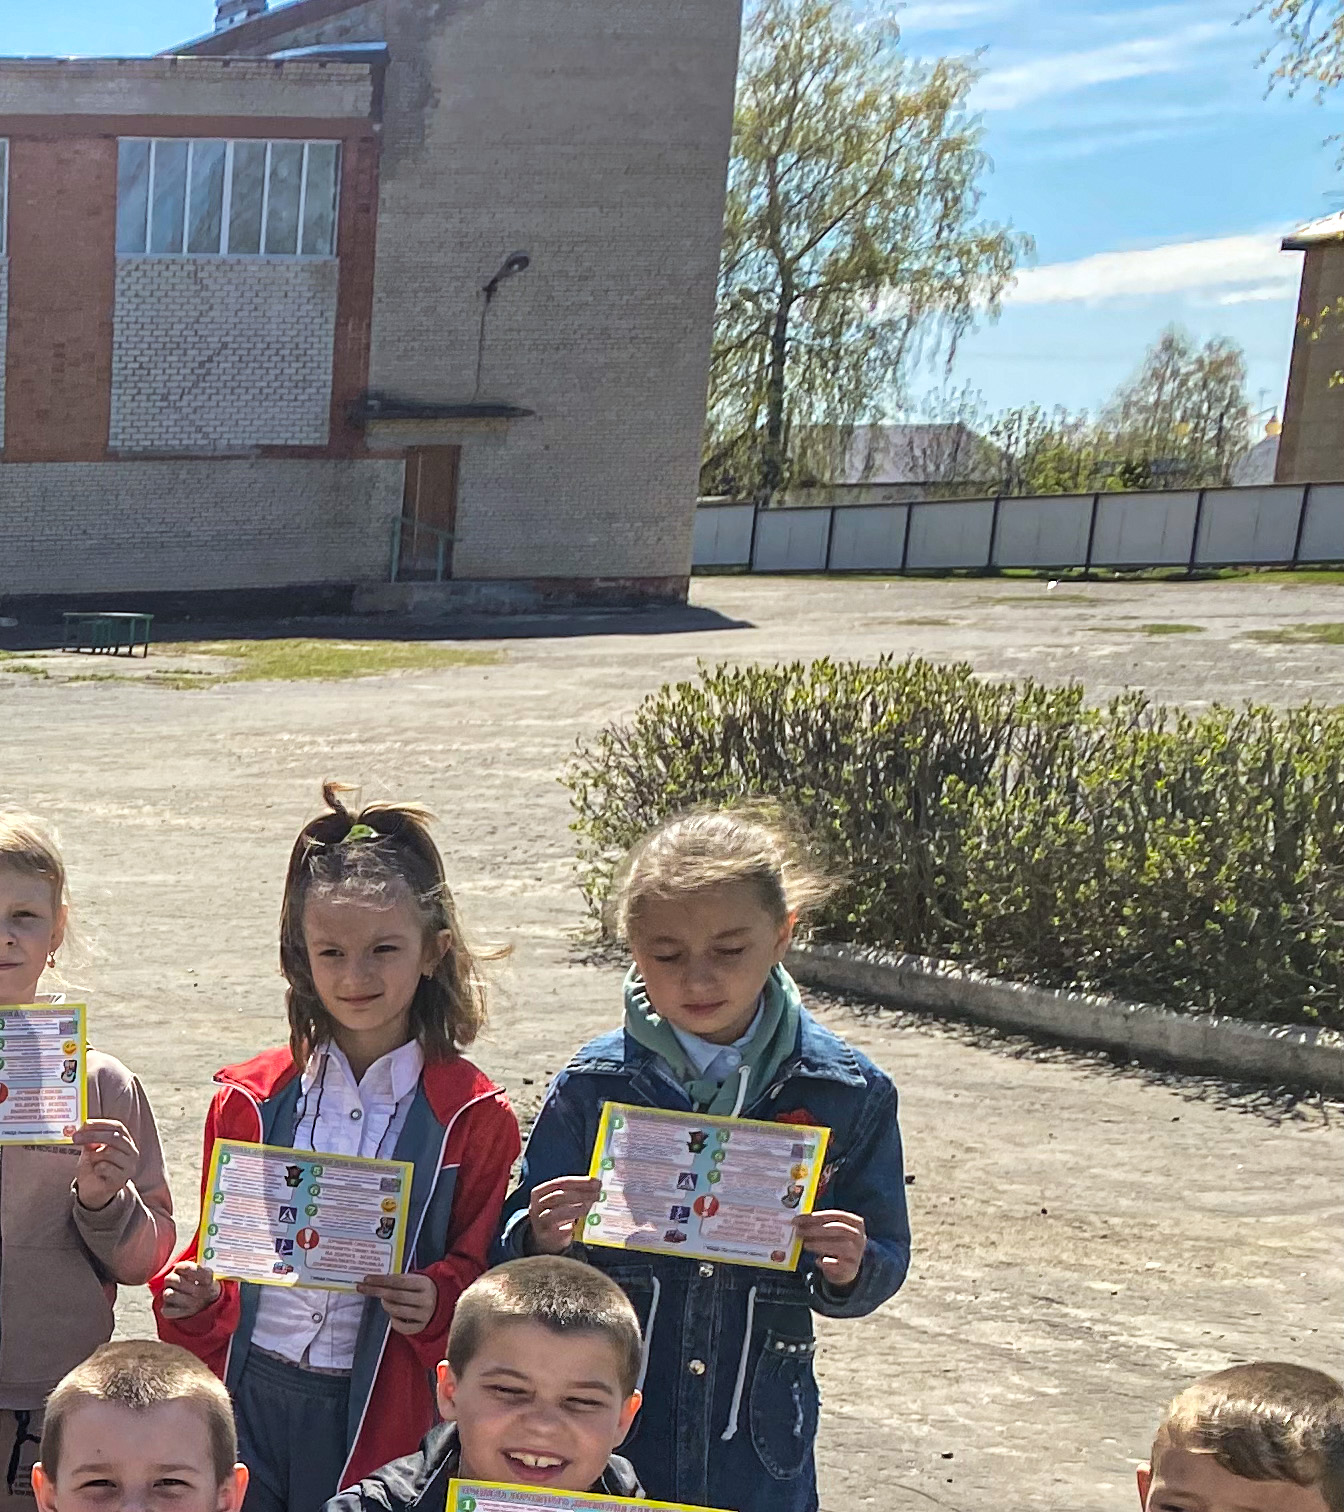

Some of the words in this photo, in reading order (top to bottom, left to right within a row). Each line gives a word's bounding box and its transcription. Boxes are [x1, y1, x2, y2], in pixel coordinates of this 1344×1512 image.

[615, 1119, 619, 1127] 1
[215, 1194, 222, 1202] 2
[463, 1500, 470, 1510] 1
